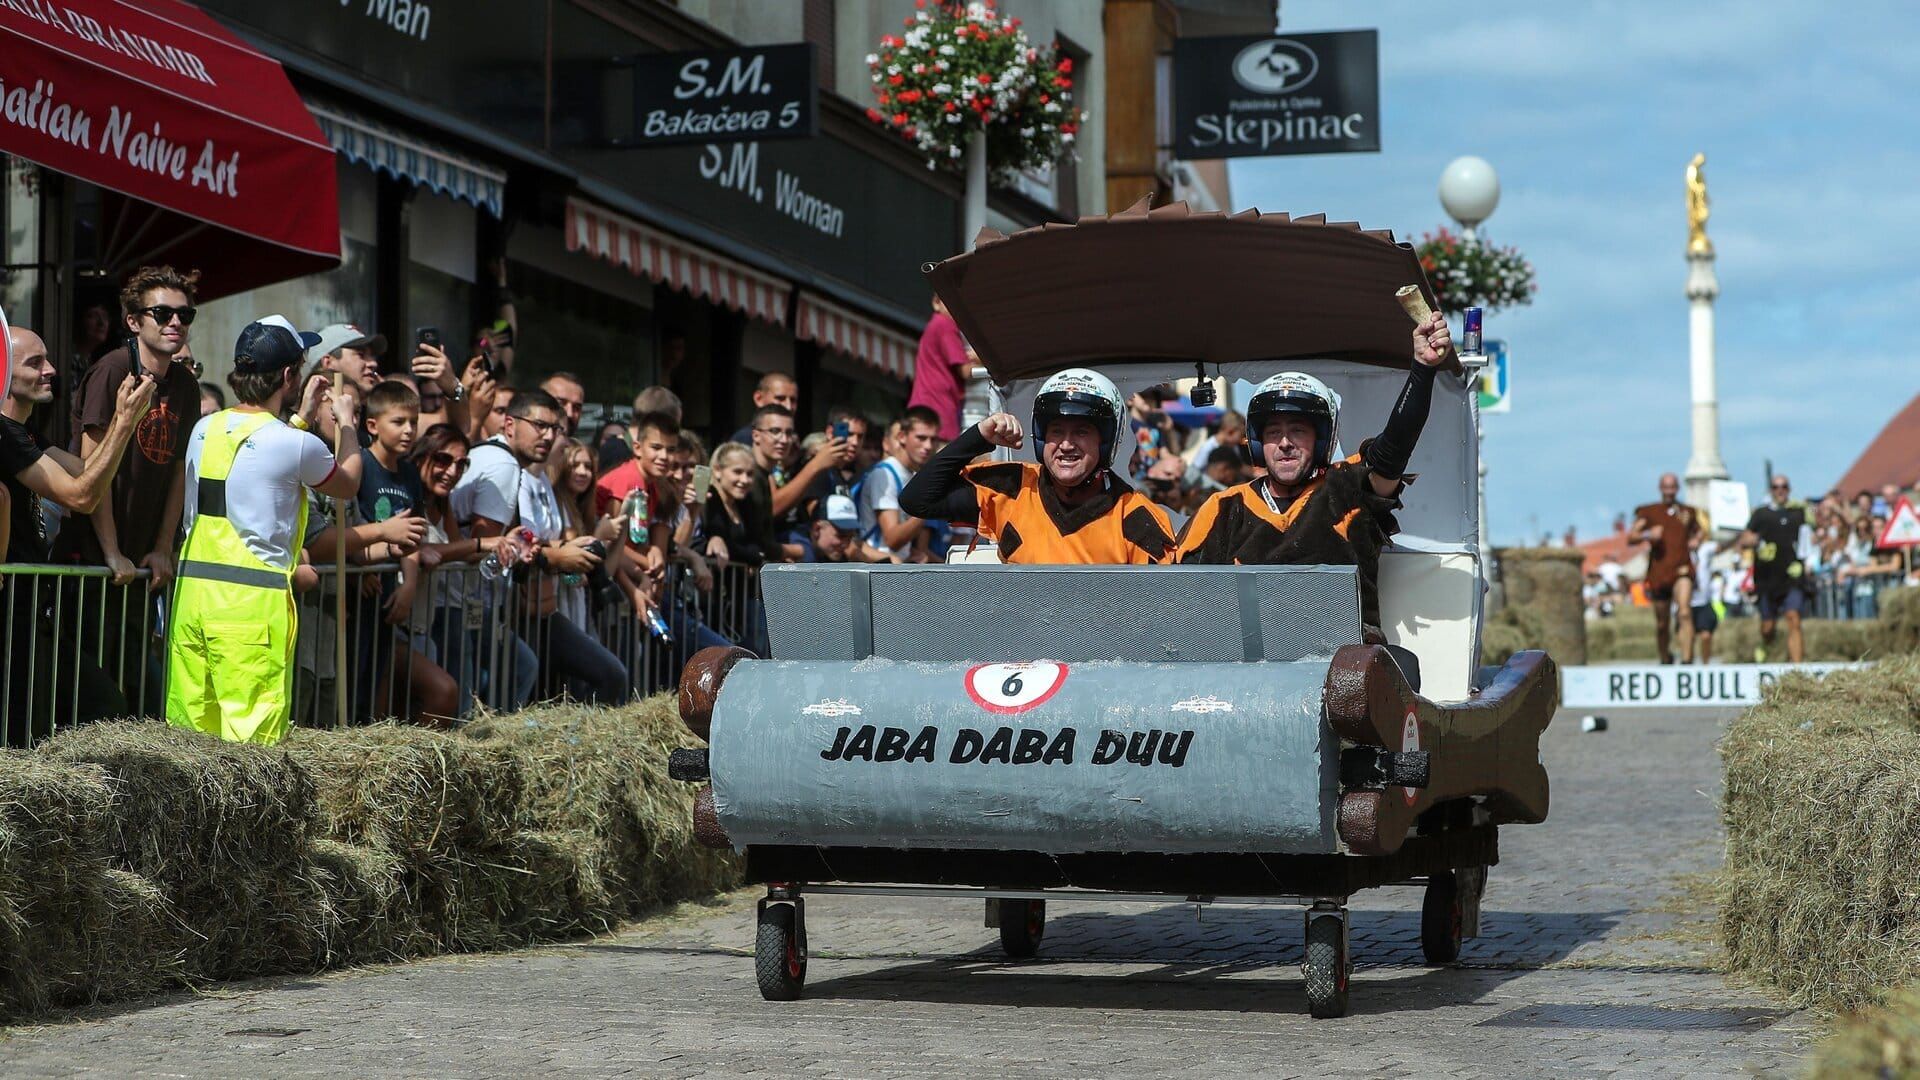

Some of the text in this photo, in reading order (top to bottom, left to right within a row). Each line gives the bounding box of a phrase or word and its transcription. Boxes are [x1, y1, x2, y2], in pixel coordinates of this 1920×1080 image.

[0, 0, 218, 87] IJA BRANIMIR
[673, 54, 772, 99] S.M.
[0, 77, 240, 198] atian Naive Art
[643, 101, 801, 138] Bakačeva 5
[1189, 110, 1364, 150] Stepinac
[775, 169, 845, 238] Woman
[1001, 671, 1024, 697] 6
[1608, 672, 1662, 700] RED
[1676, 671, 1746, 700] BULL
[820, 724, 1195, 767] JABA DABA DUU
